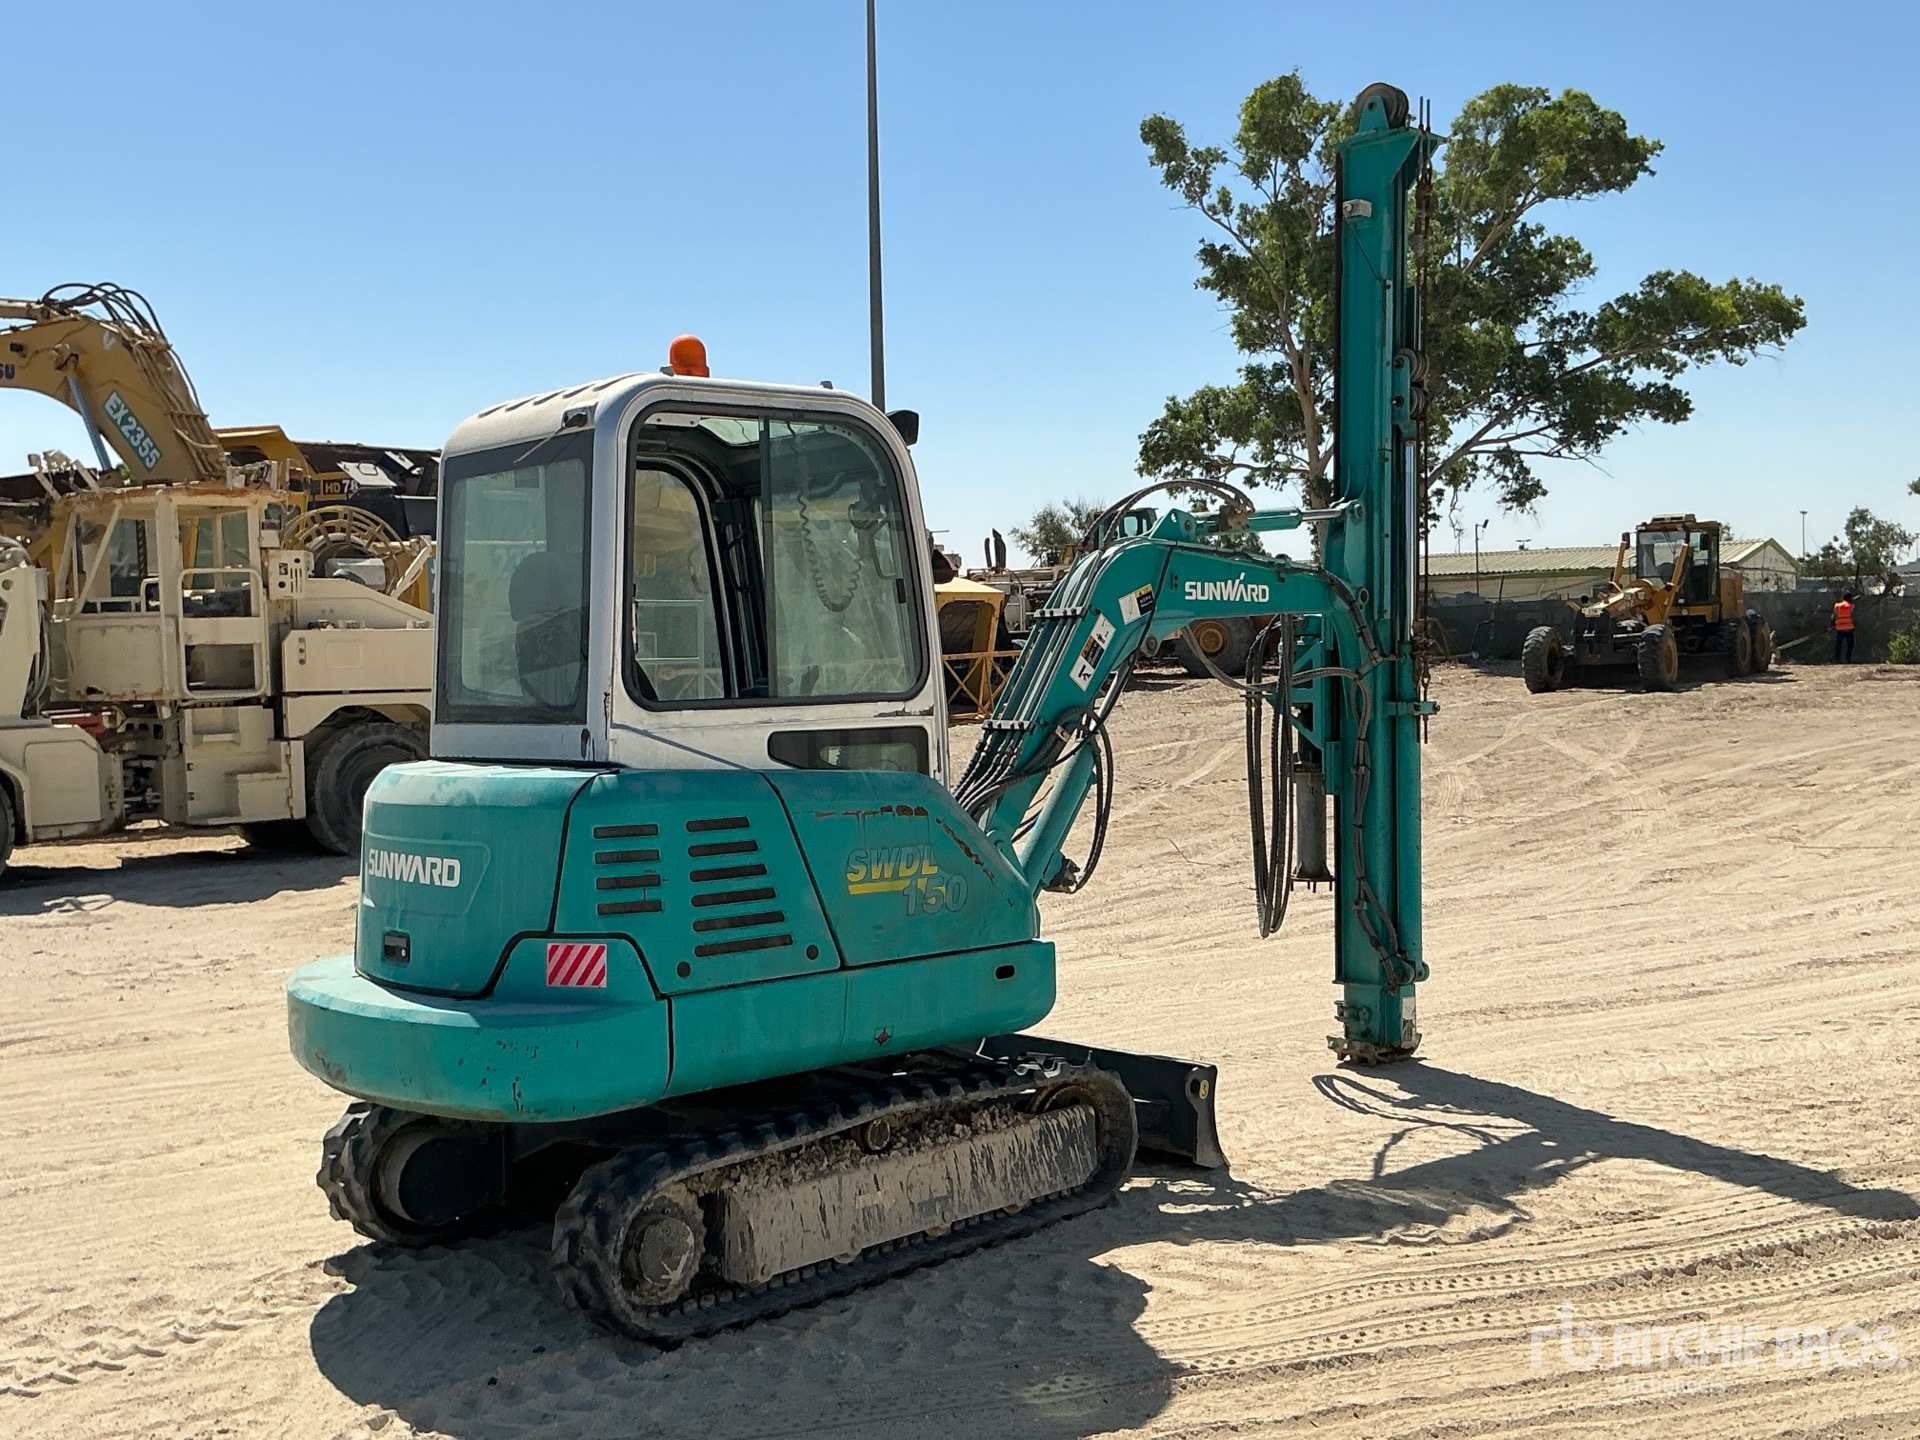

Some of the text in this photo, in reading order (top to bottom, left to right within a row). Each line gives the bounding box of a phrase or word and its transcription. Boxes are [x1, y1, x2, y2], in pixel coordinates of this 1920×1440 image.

[104, 391, 161, 468] EX2355
[325, 481, 340, 494] HD
[1185, 572, 1270, 603] SUNWARD
[368, 848, 461, 888] SUNWARD
[846, 845, 938, 882] SWDL
[903, 873, 968, 916] 150
